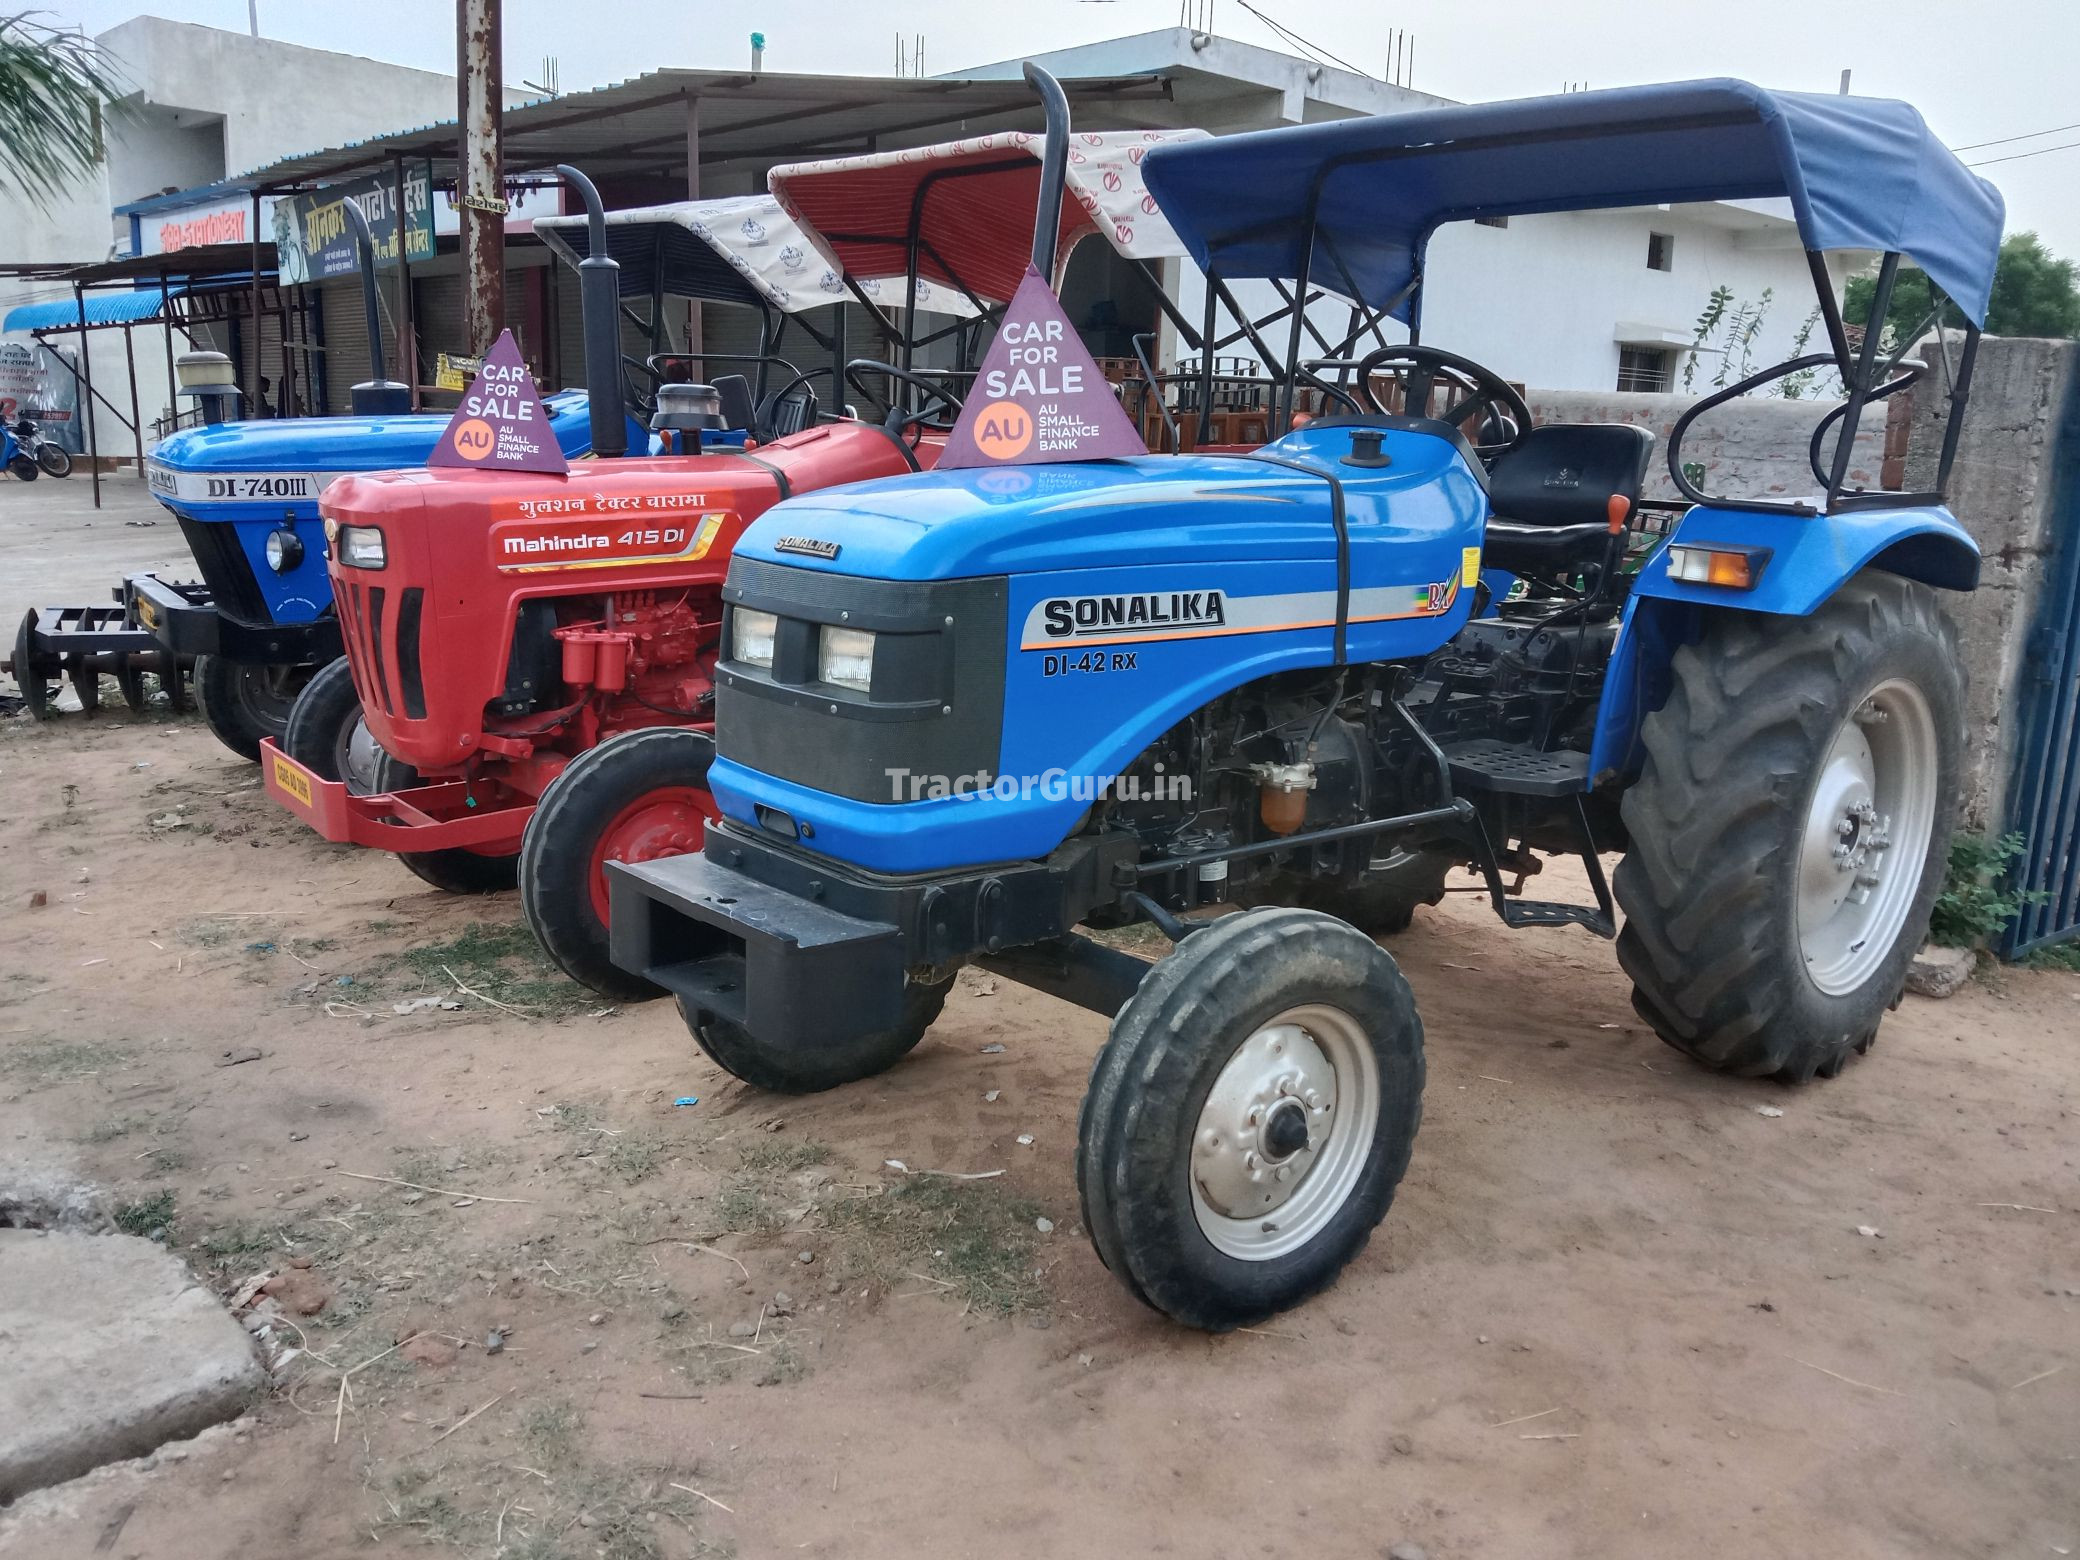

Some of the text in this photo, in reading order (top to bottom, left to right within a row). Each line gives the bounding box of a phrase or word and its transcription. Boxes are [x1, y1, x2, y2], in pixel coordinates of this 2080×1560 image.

[1002, 320, 1064, 344] CAR
[1009, 347, 1058, 366] FOR
[483, 364, 524, 382] CAR
[986, 365, 1084, 398] SALE
[485, 383, 518, 397] FOR
[466, 397, 534, 421] SALE
[1039, 404, 1058, 415] AU
[499, 425, 513, 434] AU
[981, 418, 1025, 442] AU
[1039, 415, 1084, 427] SMALL
[458, 431, 490, 448] AU
[499, 434, 530, 444] SMALL
[1039, 426, 1100, 439] FINANCE
[497, 443, 540, 454] FINANCE
[1039, 439, 1078, 451] BANK
[496, 451, 524, 461] BANK
[207, 478, 306, 497] DI-740III
[519, 493, 706, 518] गुलशन ट्रैक्टर चारामा
[504, 528, 685, 554] Mahindra 415 DI
[774, 536, 840, 558] SONALIKA
[1428, 580, 1449, 610] RX
[1044, 592, 1226, 637] SONALIKA
[1043, 652, 1138, 677] DI-42 RX
